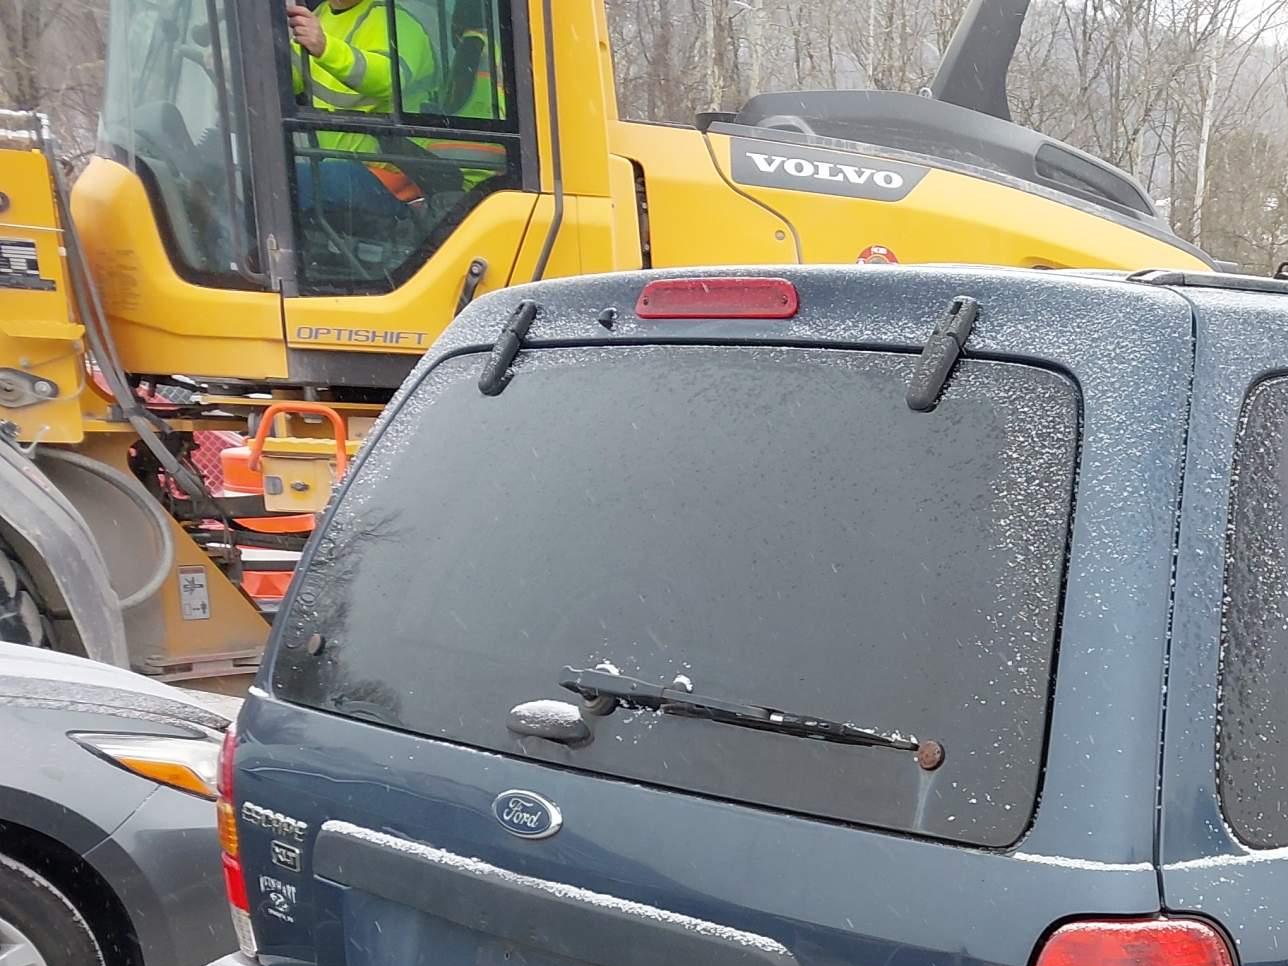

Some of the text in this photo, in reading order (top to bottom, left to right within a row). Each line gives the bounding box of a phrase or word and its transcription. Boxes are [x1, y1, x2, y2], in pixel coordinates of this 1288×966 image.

[745, 151, 904, 189] VOLVO
[296, 325, 428, 345] OPTISHIFT
[503, 797, 542, 828] Ford
